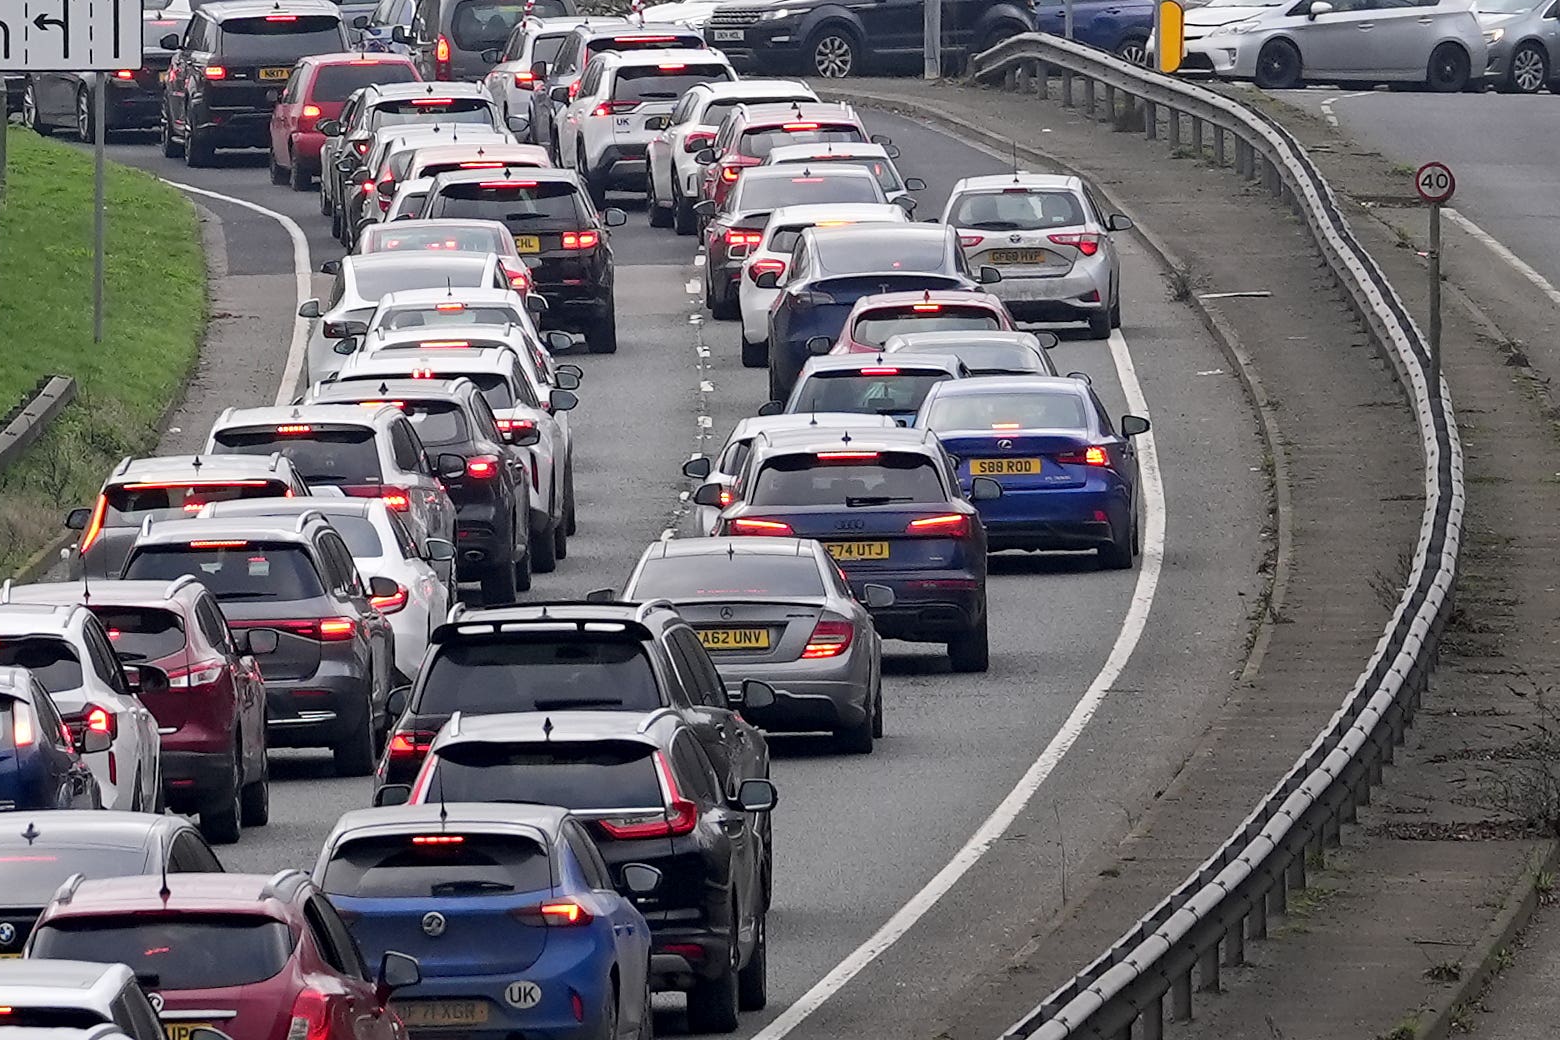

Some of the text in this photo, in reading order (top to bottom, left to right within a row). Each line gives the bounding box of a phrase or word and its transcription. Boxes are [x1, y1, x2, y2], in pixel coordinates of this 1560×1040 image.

[616, 117, 630, 126] UK
[1420, 173, 1448, 189] 40
[857, 543, 884, 556] UTJ
[697, 630, 762, 645] A62 UNV
[509, 986, 536, 1004] UK
